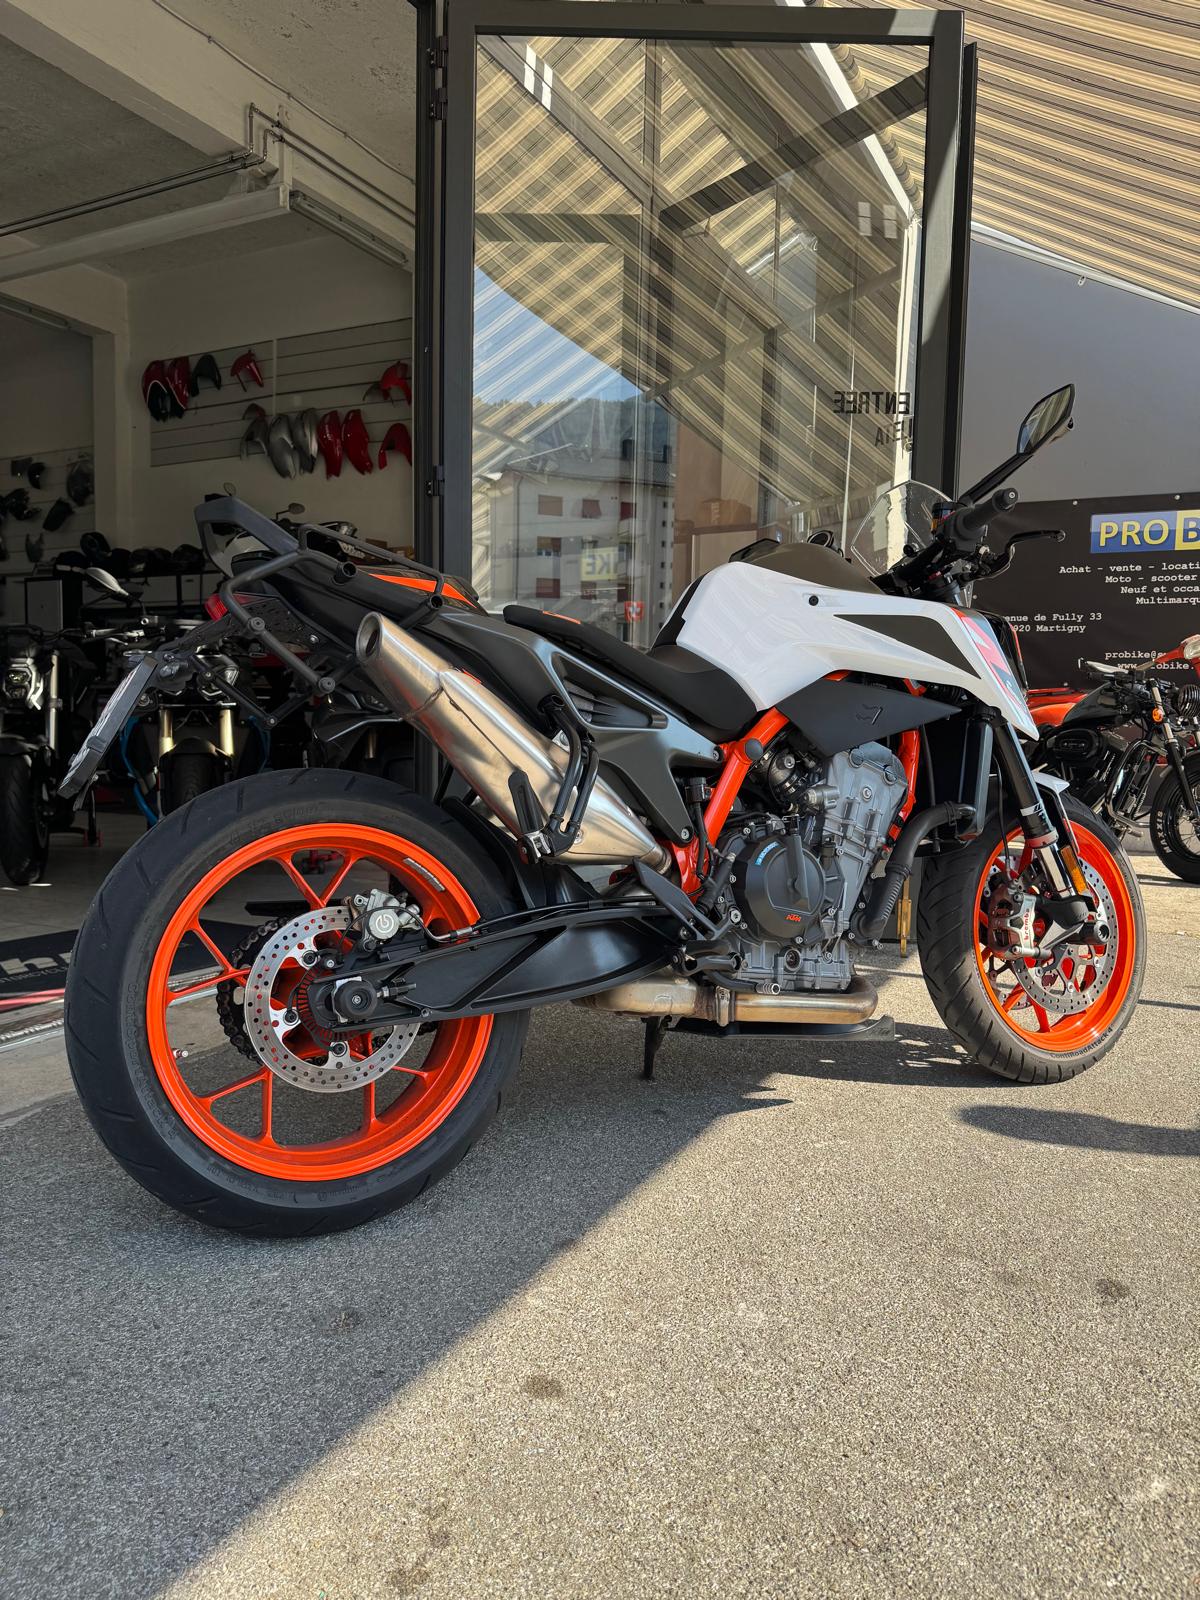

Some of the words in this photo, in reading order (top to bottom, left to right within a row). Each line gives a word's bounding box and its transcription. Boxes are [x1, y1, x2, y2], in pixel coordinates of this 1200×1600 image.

[1099, 518, 1169, 547] PRO
[1059, 565, 1092, 574] Achat
[1109, 564, 1142, 572] vente
[1161, 562, 1200, 571] locati
[1105, 575, 1132, 583] Moto
[1151, 574, 1198, 582] scooter
[1120, 585, 1147, 594] Neuf
[1153, 585, 1167, 593] et
[1173, 585, 1200, 593] occa
[1034, 613, 1047, 622] de
[1052, 612, 1084, 623] Fully
[1089, 612, 1103, 621] 33
[1036, 623, 1087, 634] Martigny
[1156, 810, 1173, 854] MAXXIS
